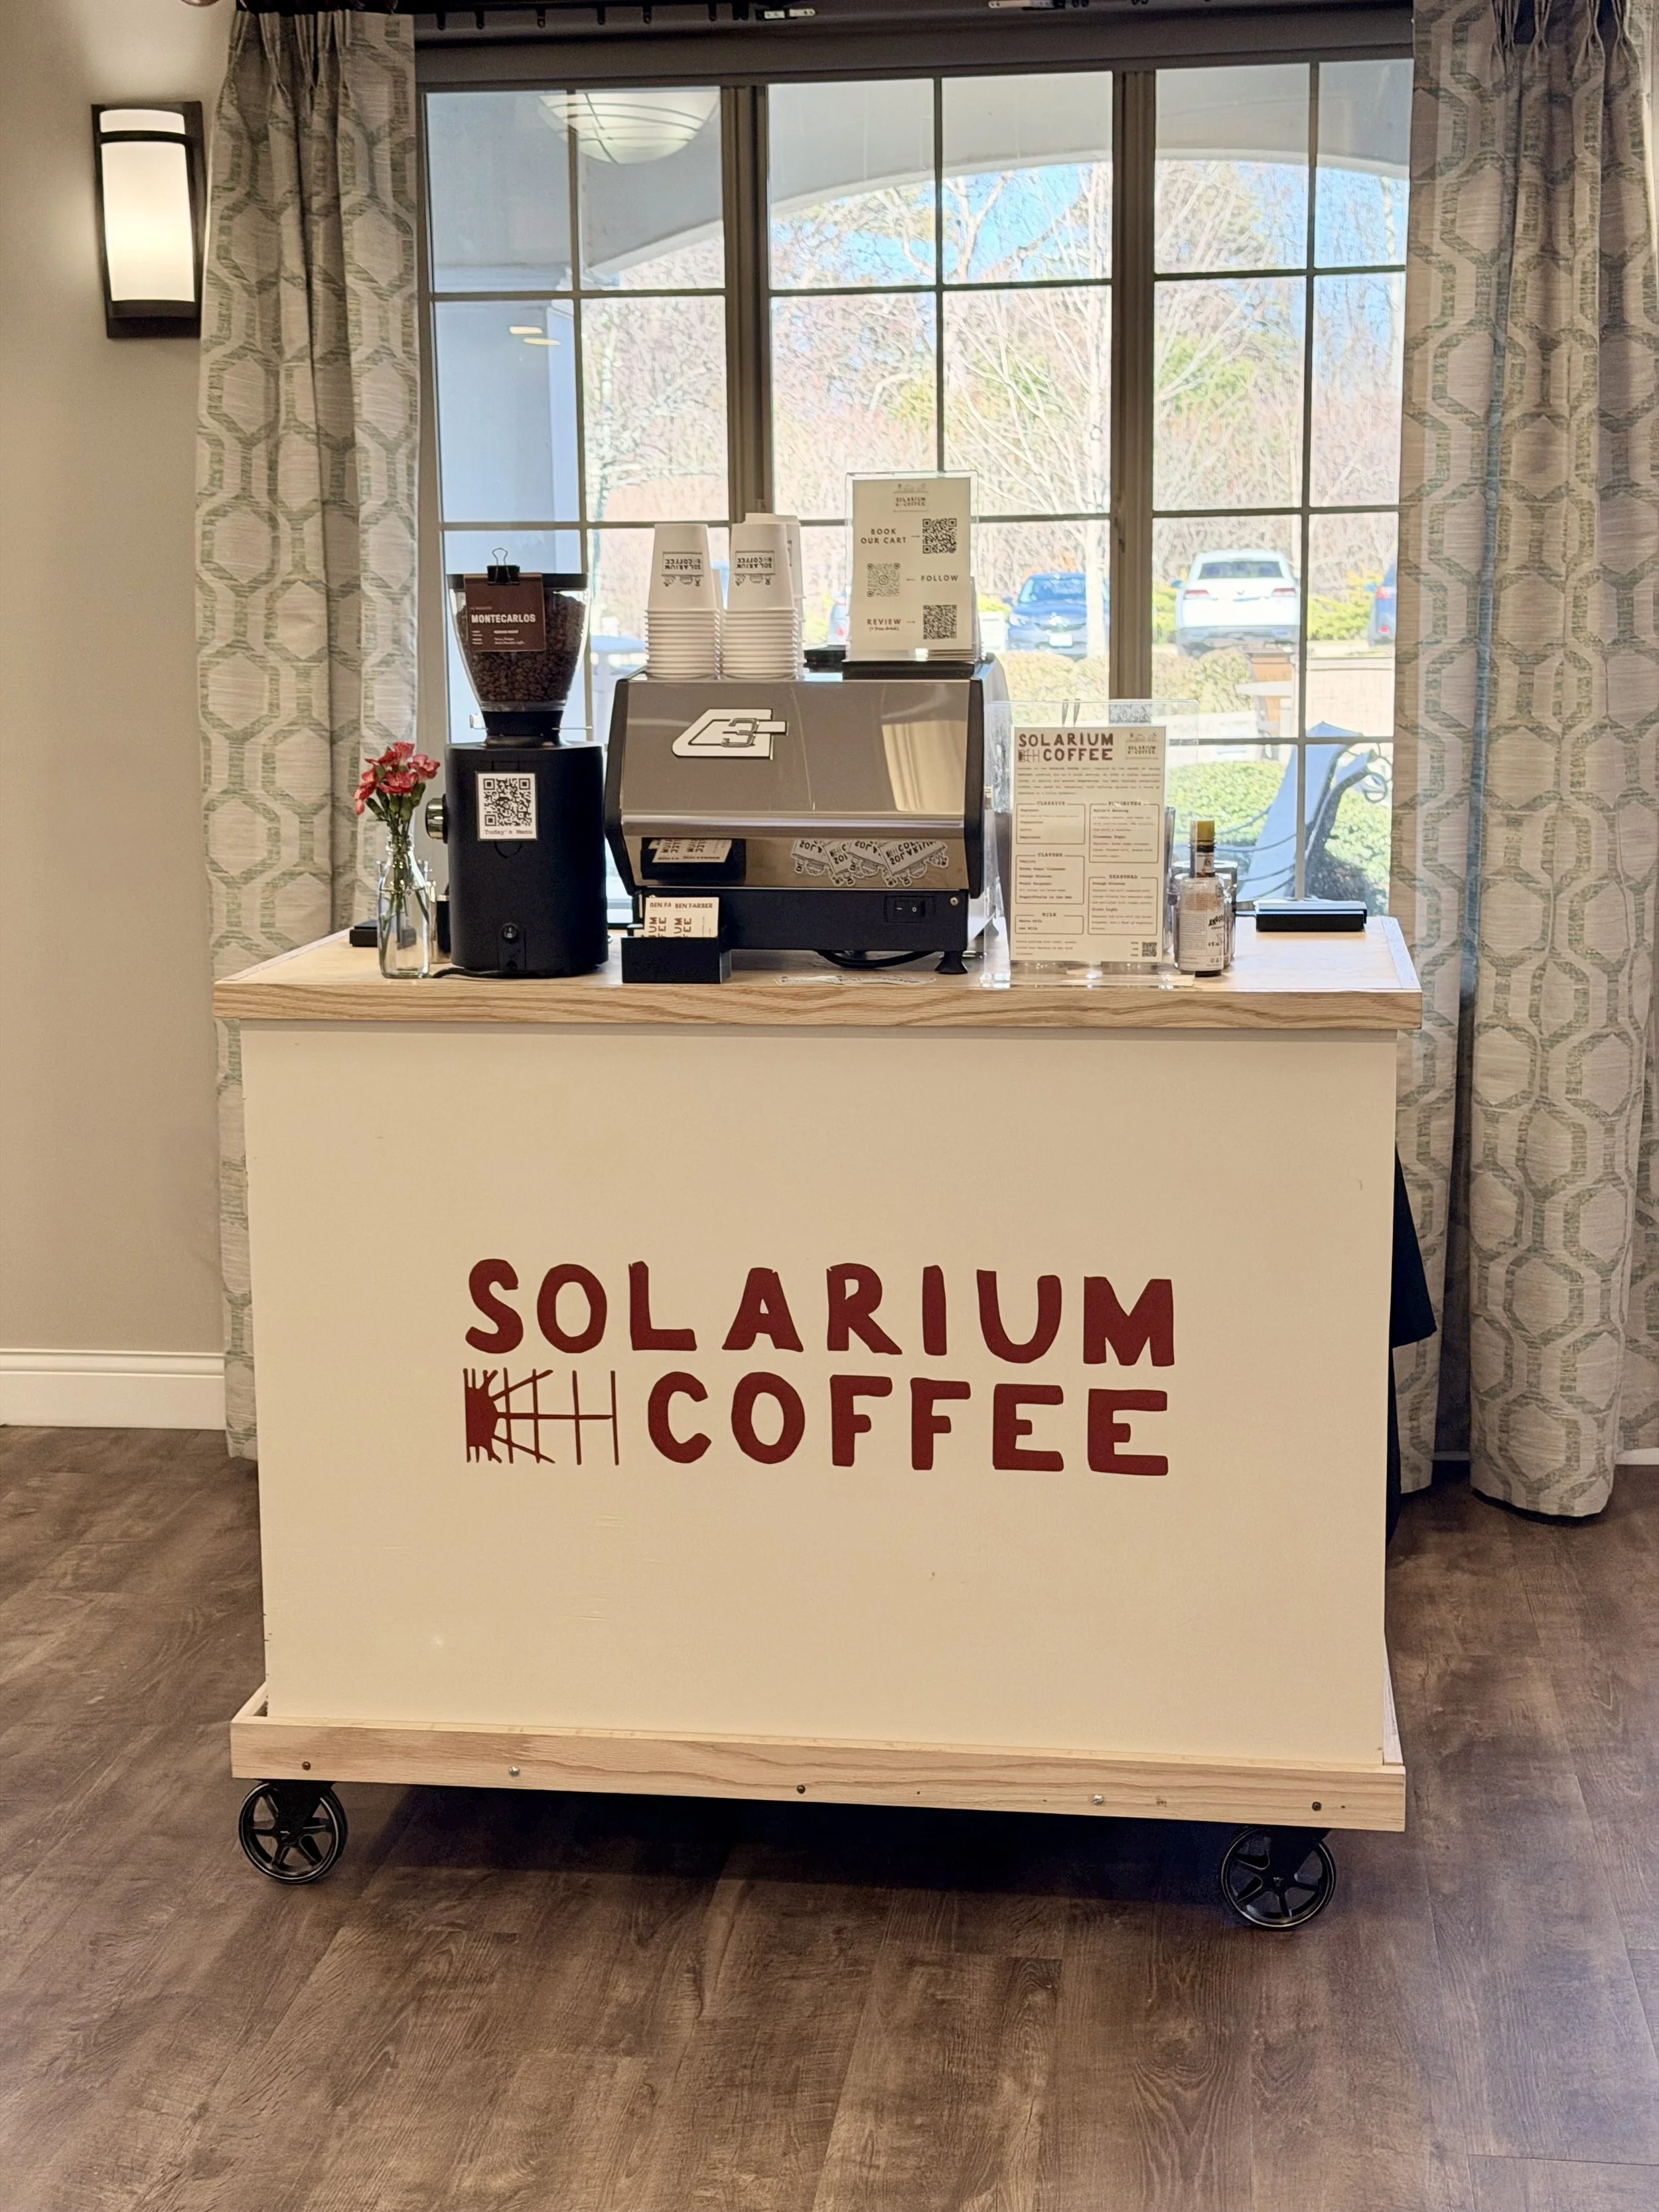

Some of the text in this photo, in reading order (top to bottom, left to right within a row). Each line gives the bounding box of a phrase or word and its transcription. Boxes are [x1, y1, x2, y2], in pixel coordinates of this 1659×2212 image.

[470, 614, 536, 623] MONTECARLOS
[1019, 732, 1114, 747] SOLARIUM
[1043, 748, 1114, 761] COFFEE
[465, 1258, 1175, 1366] SOLARIUM
[647, 1370, 1169, 1476] COFFEE
